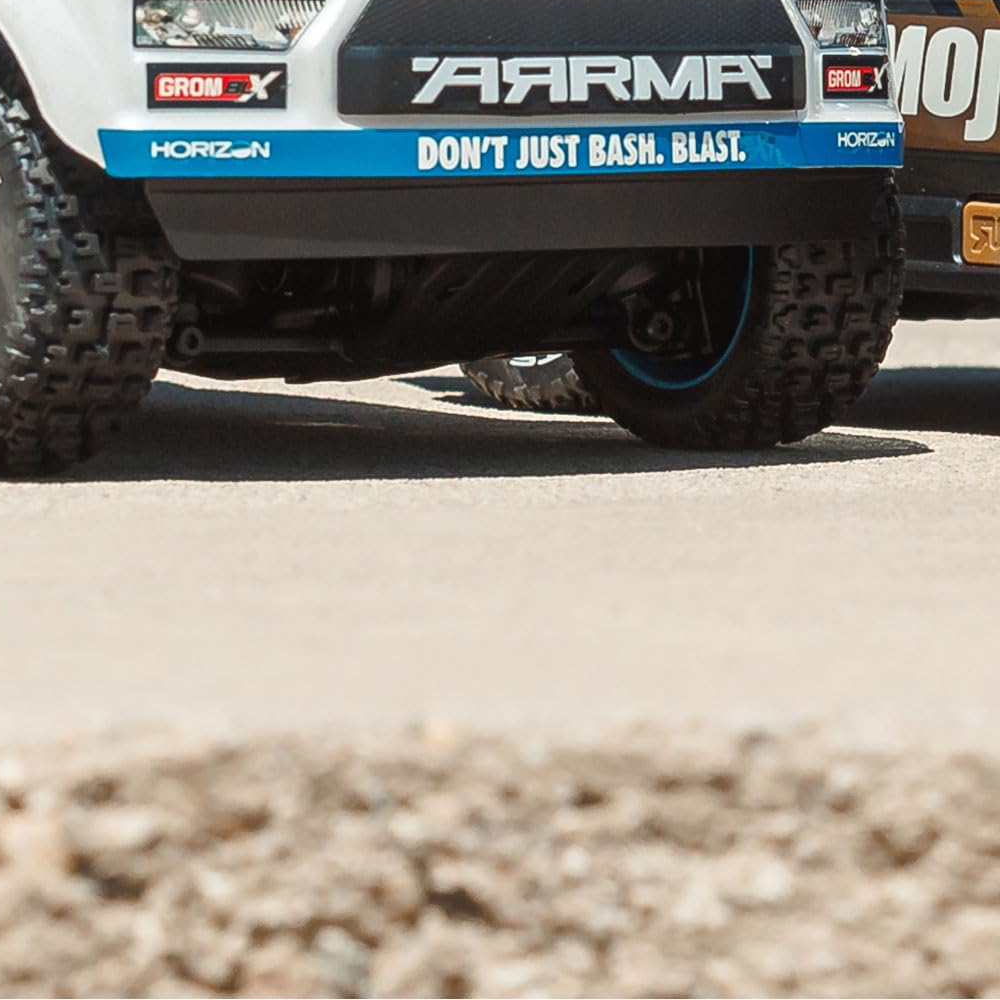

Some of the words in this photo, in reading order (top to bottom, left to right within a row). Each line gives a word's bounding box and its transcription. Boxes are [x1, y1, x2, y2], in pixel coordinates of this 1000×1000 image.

[158, 76, 224, 98] GROM
[412, 55, 772, 104] ARRMA
[828, 69, 862, 89] GROM
[151, 140, 270, 159] HORIZON
[418, 136, 508, 170] DON'T
[516, 134, 580, 169] JUST
[588, 132, 664, 167] BASH.
[671, 130, 746, 163] BLAST.
[837, 132, 895, 148] HORIZON
